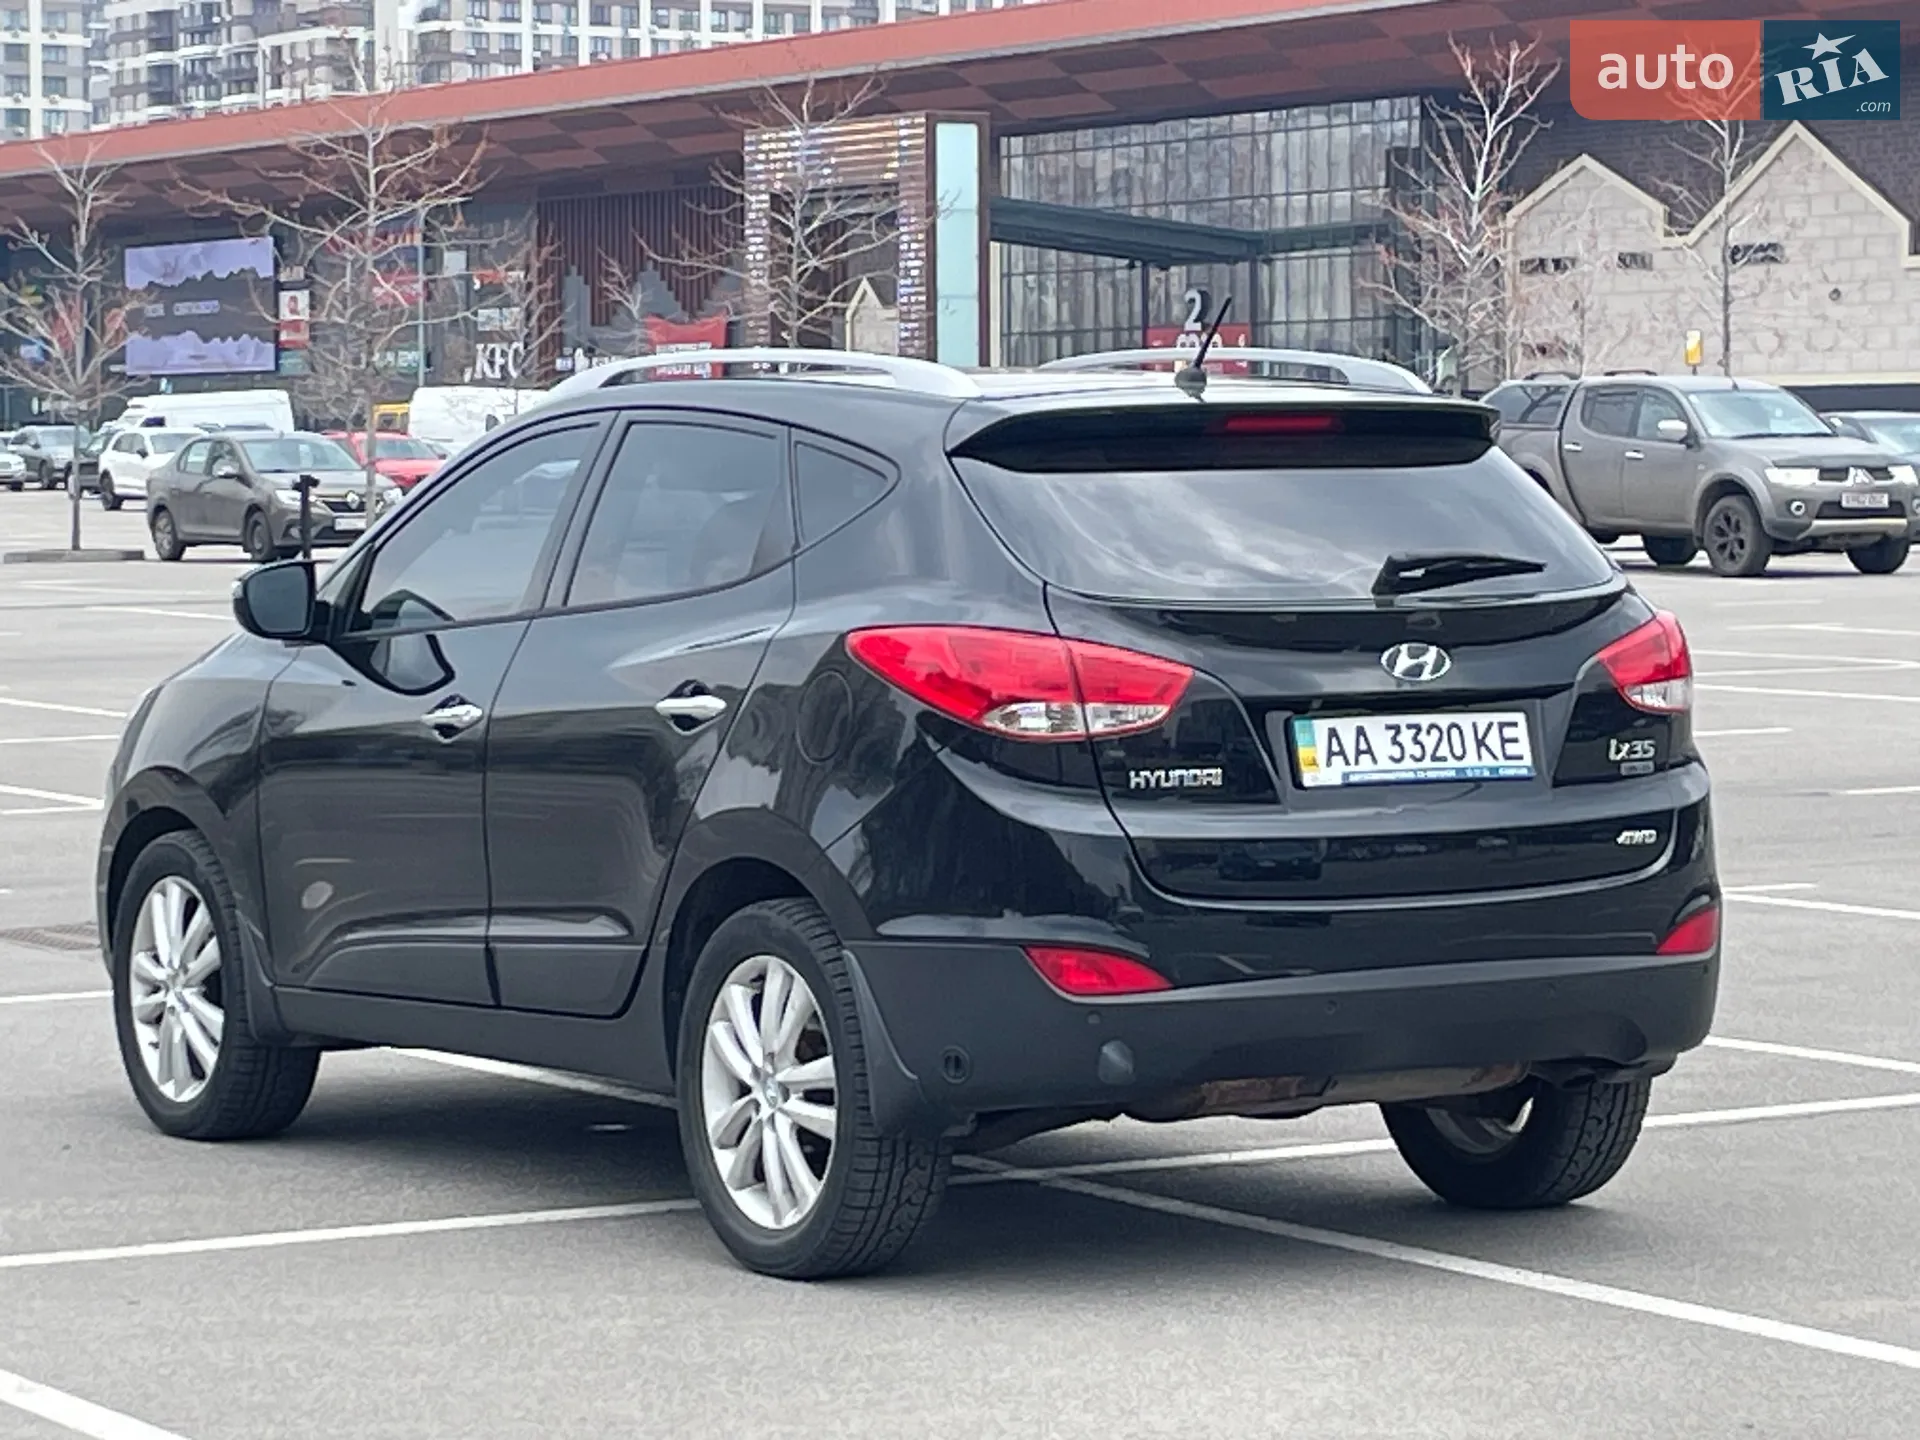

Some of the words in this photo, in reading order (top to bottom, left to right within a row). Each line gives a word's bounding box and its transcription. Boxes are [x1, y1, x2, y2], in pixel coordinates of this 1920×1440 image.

[1184, 289, 1202, 331] 2
[473, 341, 525, 379] KFC
[1326, 726, 1378, 768] AA
[1384, 722, 1467, 764] 3320
[1472, 721, 1524, 762] KE
[1128, 767, 1223, 789] HYUNDAI
